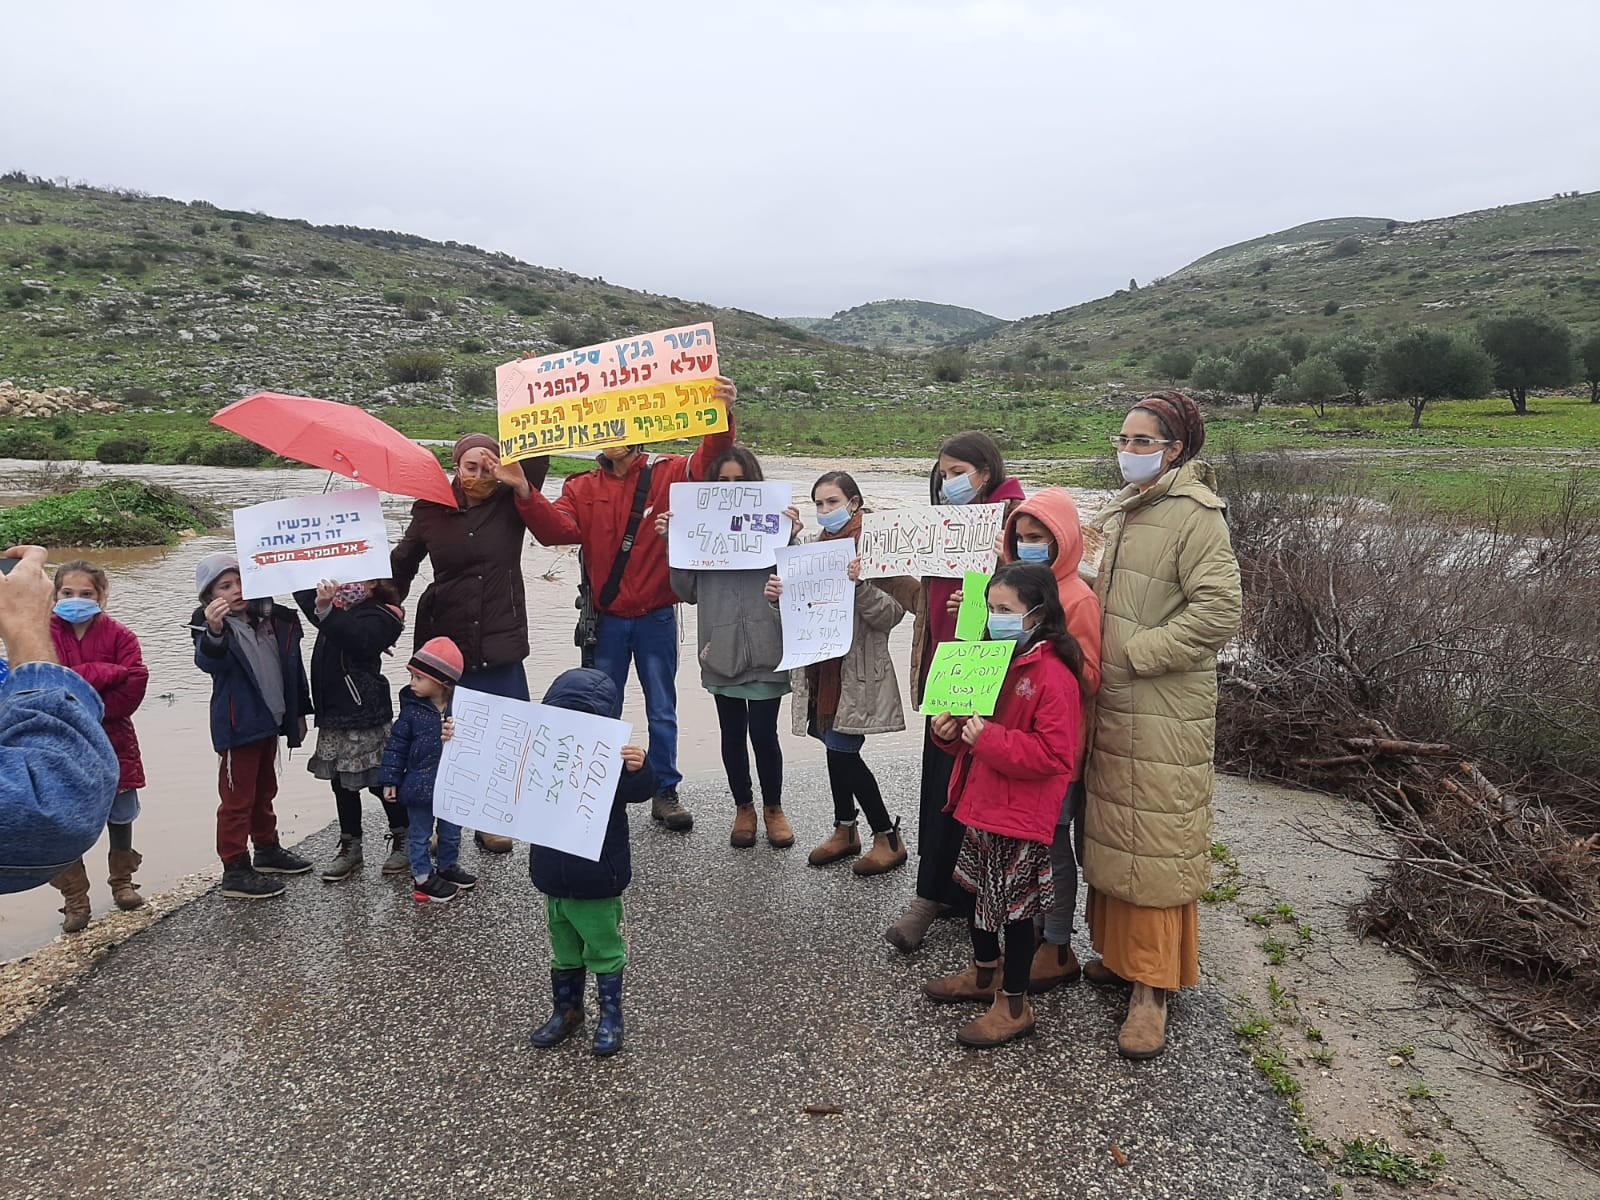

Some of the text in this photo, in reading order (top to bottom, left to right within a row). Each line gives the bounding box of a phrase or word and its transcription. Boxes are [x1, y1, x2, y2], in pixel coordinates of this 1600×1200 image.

[664, 329, 711, 349] השר
[600, 362, 658, 388] יכולנו
[671, 352, 712, 375] שלא
[527, 371, 590, 405] להפגין
[675, 385, 715, 407] מול
[572, 397, 607, 423] שלך
[617, 392, 666, 412] הבית
[696, 408, 718, 426] כי
[541, 424, 565, 445] לנו
[568, 424, 590, 448] אין
[593, 419, 625, 440] שוב
[696, 486, 763, 510] רוצים
[277, 516, 321, 530] עכשיו
[730, 513, 780, 535] כביש
[256, 528, 342, 547] זה רק אתה.
[342, 542, 359, 553] אל
[688, 523, 763, 555] נורמלי
[944, 522, 996, 553] שוב
[258, 550, 295, 564] תסדיר
[442, 700, 490, 817] הסדרה
[527, 724, 550, 791] גם ילדי
[569, 744, 585, 789] רוצים
[545, 735, 575, 805] מעוז צבי
